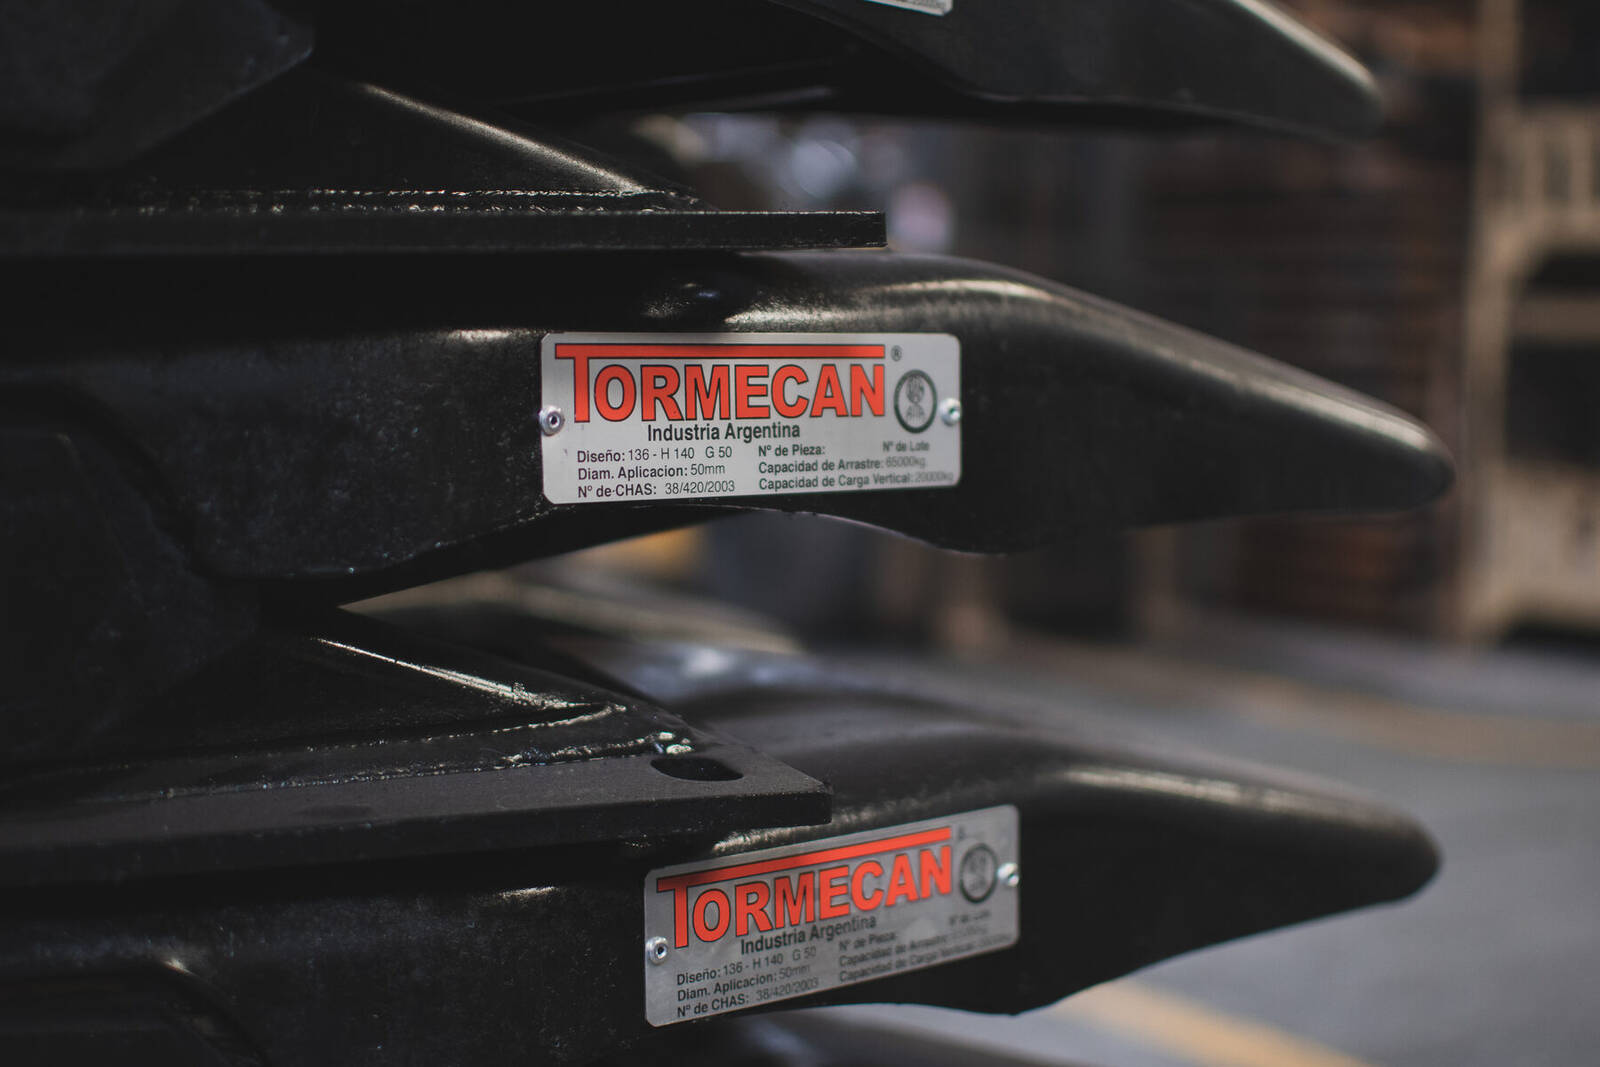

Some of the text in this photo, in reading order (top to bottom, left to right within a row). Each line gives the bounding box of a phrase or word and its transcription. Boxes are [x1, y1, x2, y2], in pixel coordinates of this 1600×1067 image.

[555, 343, 885, 423] TORMECAN
[648, 421, 800, 443] Industria Argentina
[577, 450, 625, 463] Diseño:
[628, 449, 649, 461] 136
[661, 448, 670, 459] H
[674, 447, 694, 459] 140
[705, 446, 715, 459] G
[718, 446, 732, 458] 50
[774, 444, 788, 456] de
[792, 443, 825, 456] Pieza:
[578, 463, 725, 481] Diam. Aplicacion: 50mm
[758, 460, 818, 475] Capacidad
[821, 458, 835, 471] de
[838, 458, 884, 470] Arrastre:
[615, 483, 656, 497] CHAS:
[665, 480, 735, 495] 38/420/2003
[759, 476, 818, 492] Capacidad
[821, 475, 835, 487] de
[838, 474, 870, 487] Carga
[656, 826, 952, 949] TORMECAN
[741, 916, 876, 955] Industria Argentina
[677, 968, 721, 986] Diseño:
[724, 962, 743, 976] 136
[765, 953, 783, 967] 140
[804, 946, 816, 959] 50
[677, 986, 711, 1002] Diam.
[694, 1002, 709, 1014] de
